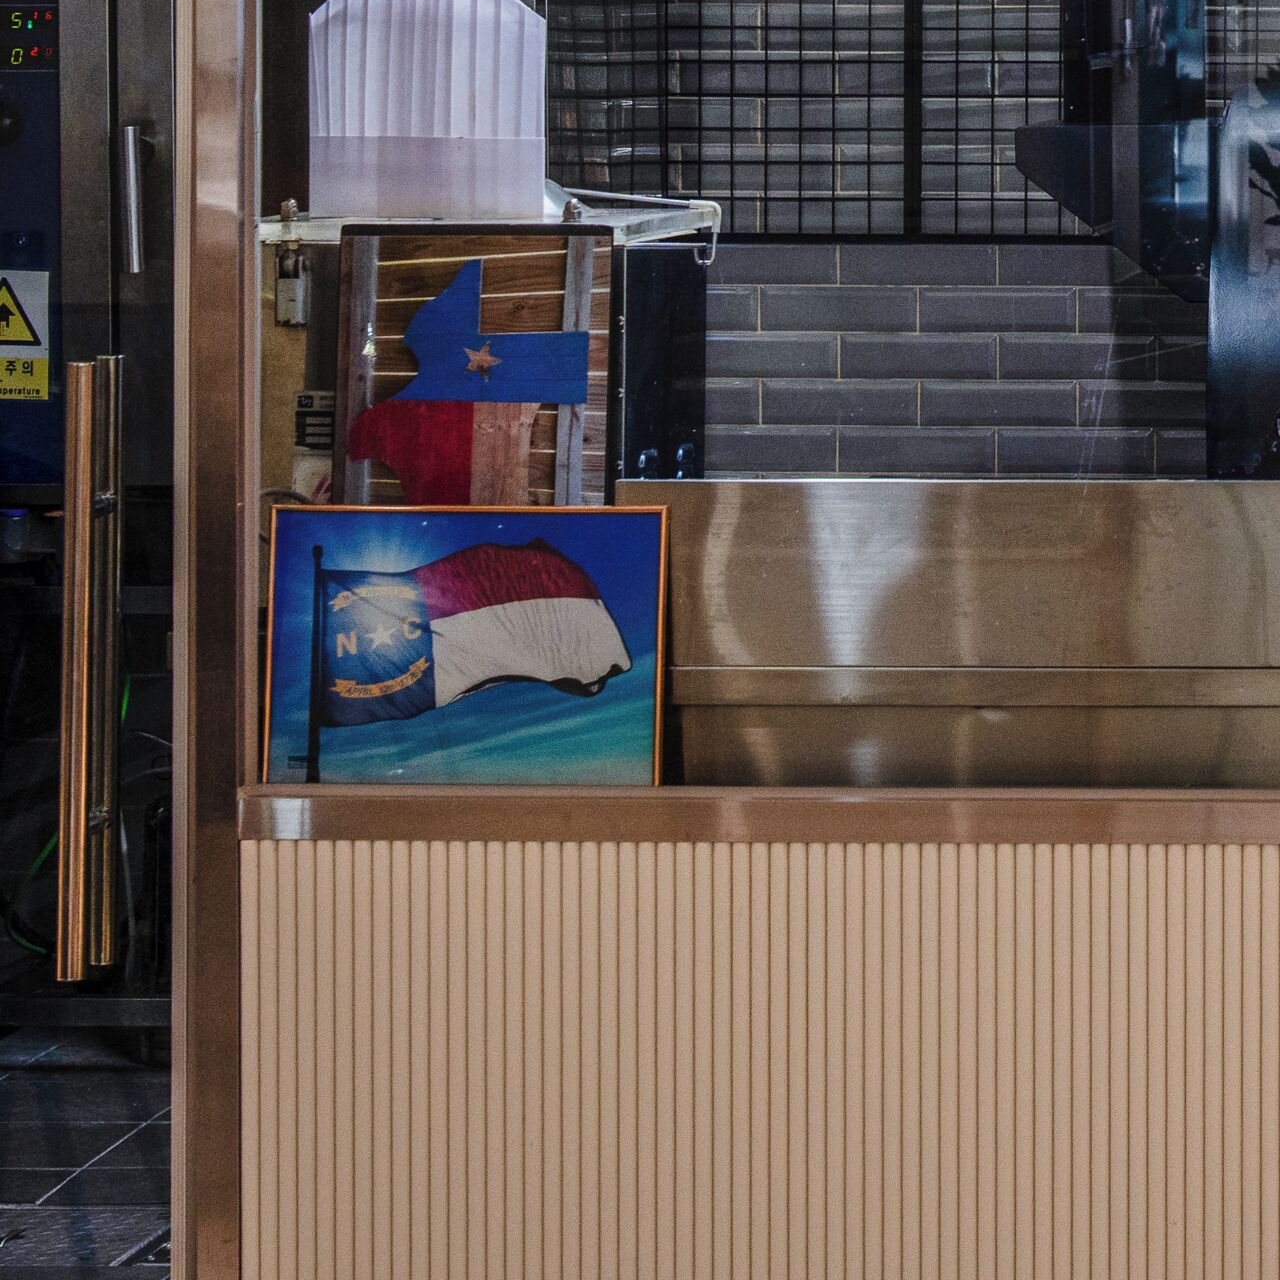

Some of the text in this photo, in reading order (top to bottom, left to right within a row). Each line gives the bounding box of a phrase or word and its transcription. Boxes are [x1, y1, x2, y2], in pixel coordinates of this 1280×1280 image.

[0, 387, 41, 396] perature
[336, 616, 422, 657] N C
